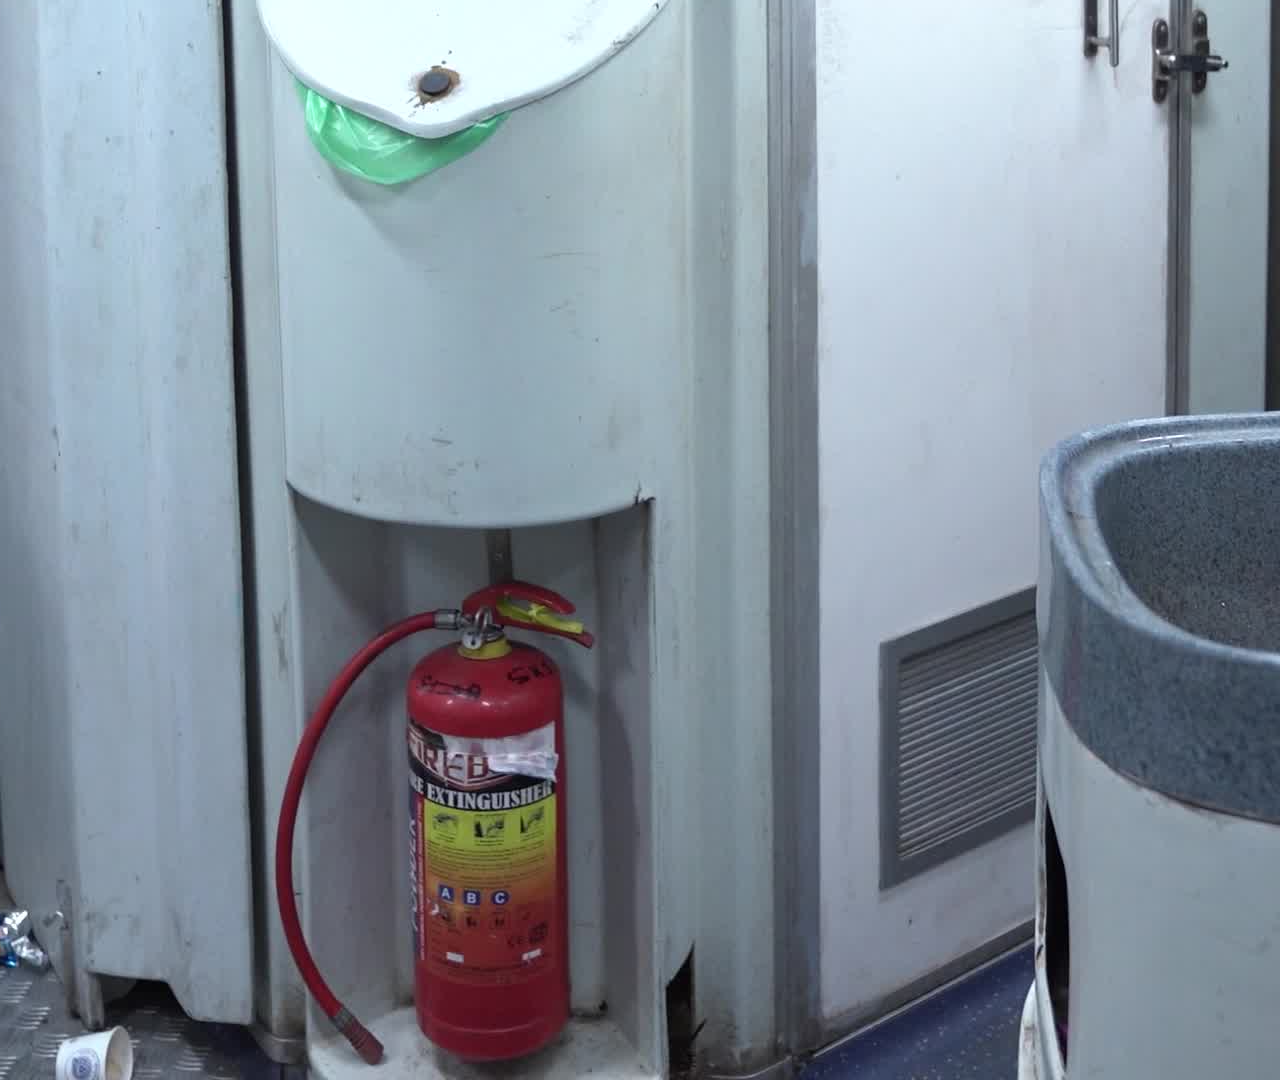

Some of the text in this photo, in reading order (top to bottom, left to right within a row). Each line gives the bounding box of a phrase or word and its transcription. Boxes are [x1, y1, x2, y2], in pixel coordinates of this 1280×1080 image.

[441, 887, 506, 904] A B C
